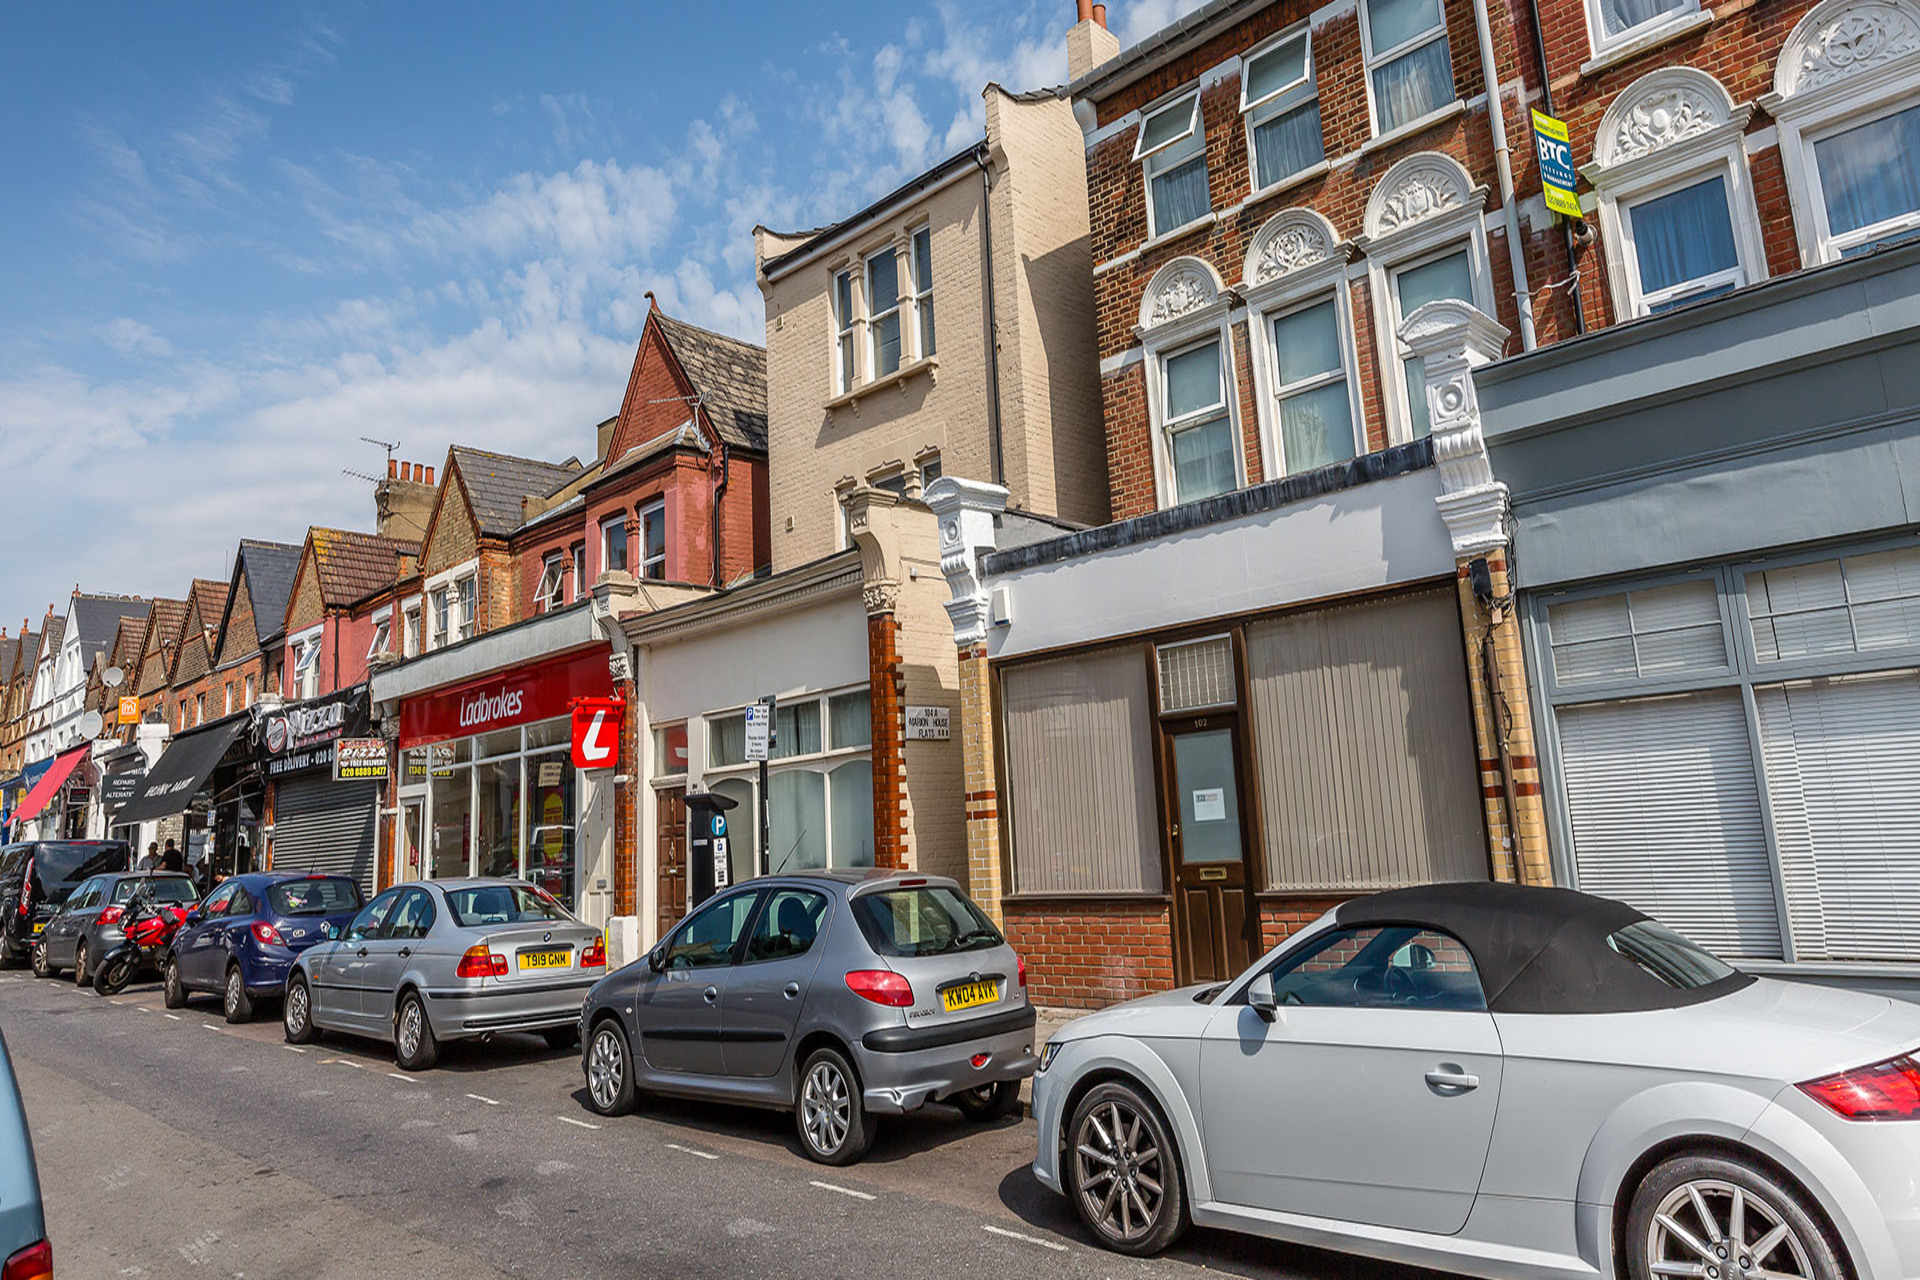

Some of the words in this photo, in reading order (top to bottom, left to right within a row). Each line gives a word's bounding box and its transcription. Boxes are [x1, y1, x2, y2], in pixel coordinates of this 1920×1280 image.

[1538, 135, 1570, 170] BTC
[460, 686, 523, 727] Ladbrokes
[908, 717, 928, 727] MARION
[933, 718, 948, 727] HOUSE
[1194, 718, 1208, 729] 102
[919, 729, 934, 738] FLATS
[341, 748, 386, 758] PIZZA
[270, 759, 282, 775] FREE
[284, 753, 310, 772] DELIVERY
[315, 750, 327, 765] 020
[342, 767, 354, 777] 020
[355, 767, 371, 777] 8889
[372, 766, 386, 776] 9477
[112, 779, 136, 787] REPAIRS
[716, 816, 724, 835] P
[526, 953, 546, 967] T919
[549, 953, 566, 966] GNM
[948, 986, 976, 1007] KW04
[978, 981, 995, 1000] AVK
